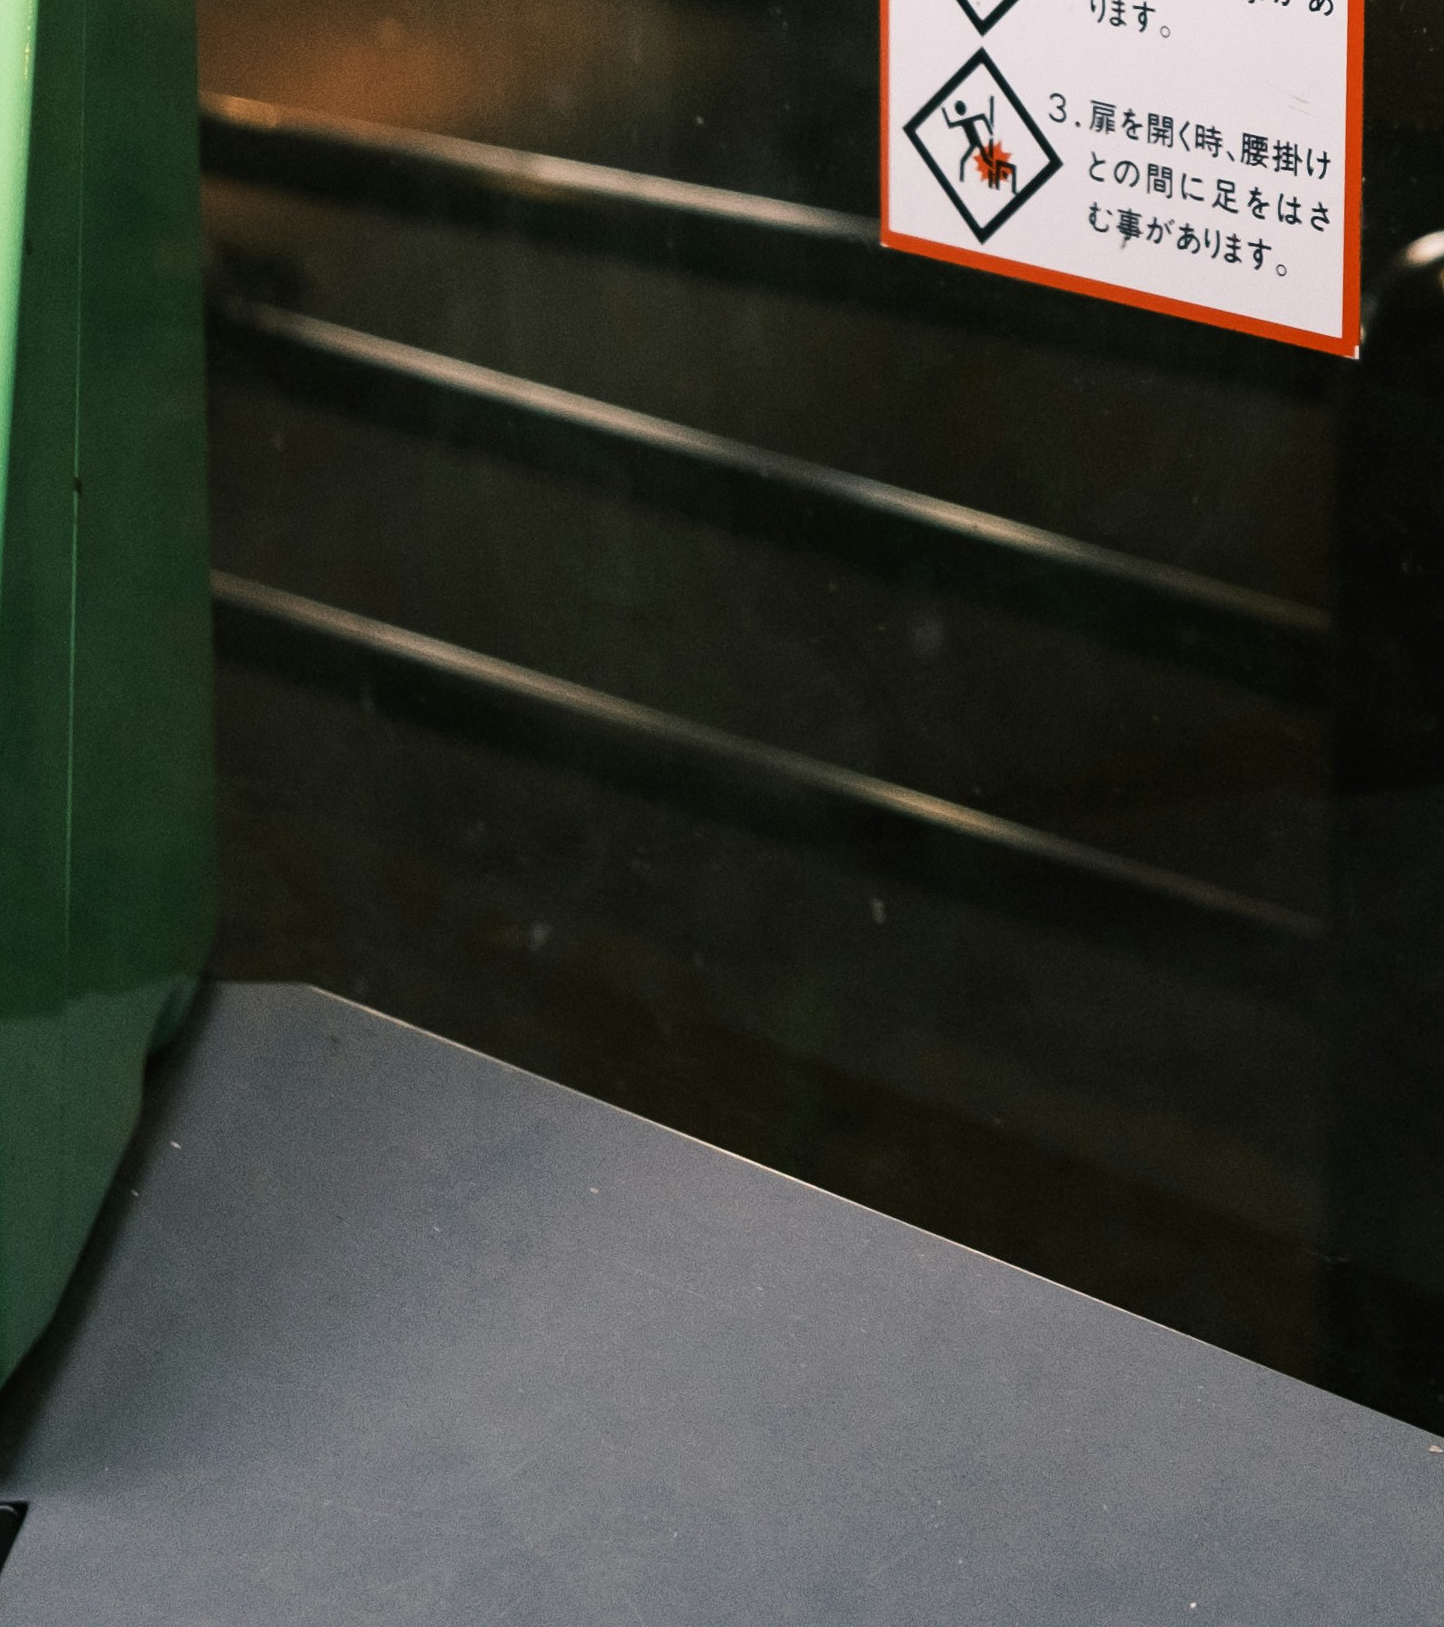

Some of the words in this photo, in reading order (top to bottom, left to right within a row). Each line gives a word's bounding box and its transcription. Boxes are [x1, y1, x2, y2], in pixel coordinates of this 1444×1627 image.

[1088, 151, 1332, 233] との間に足をはさ
[1088, 202, 1288, 278] む事があります。
